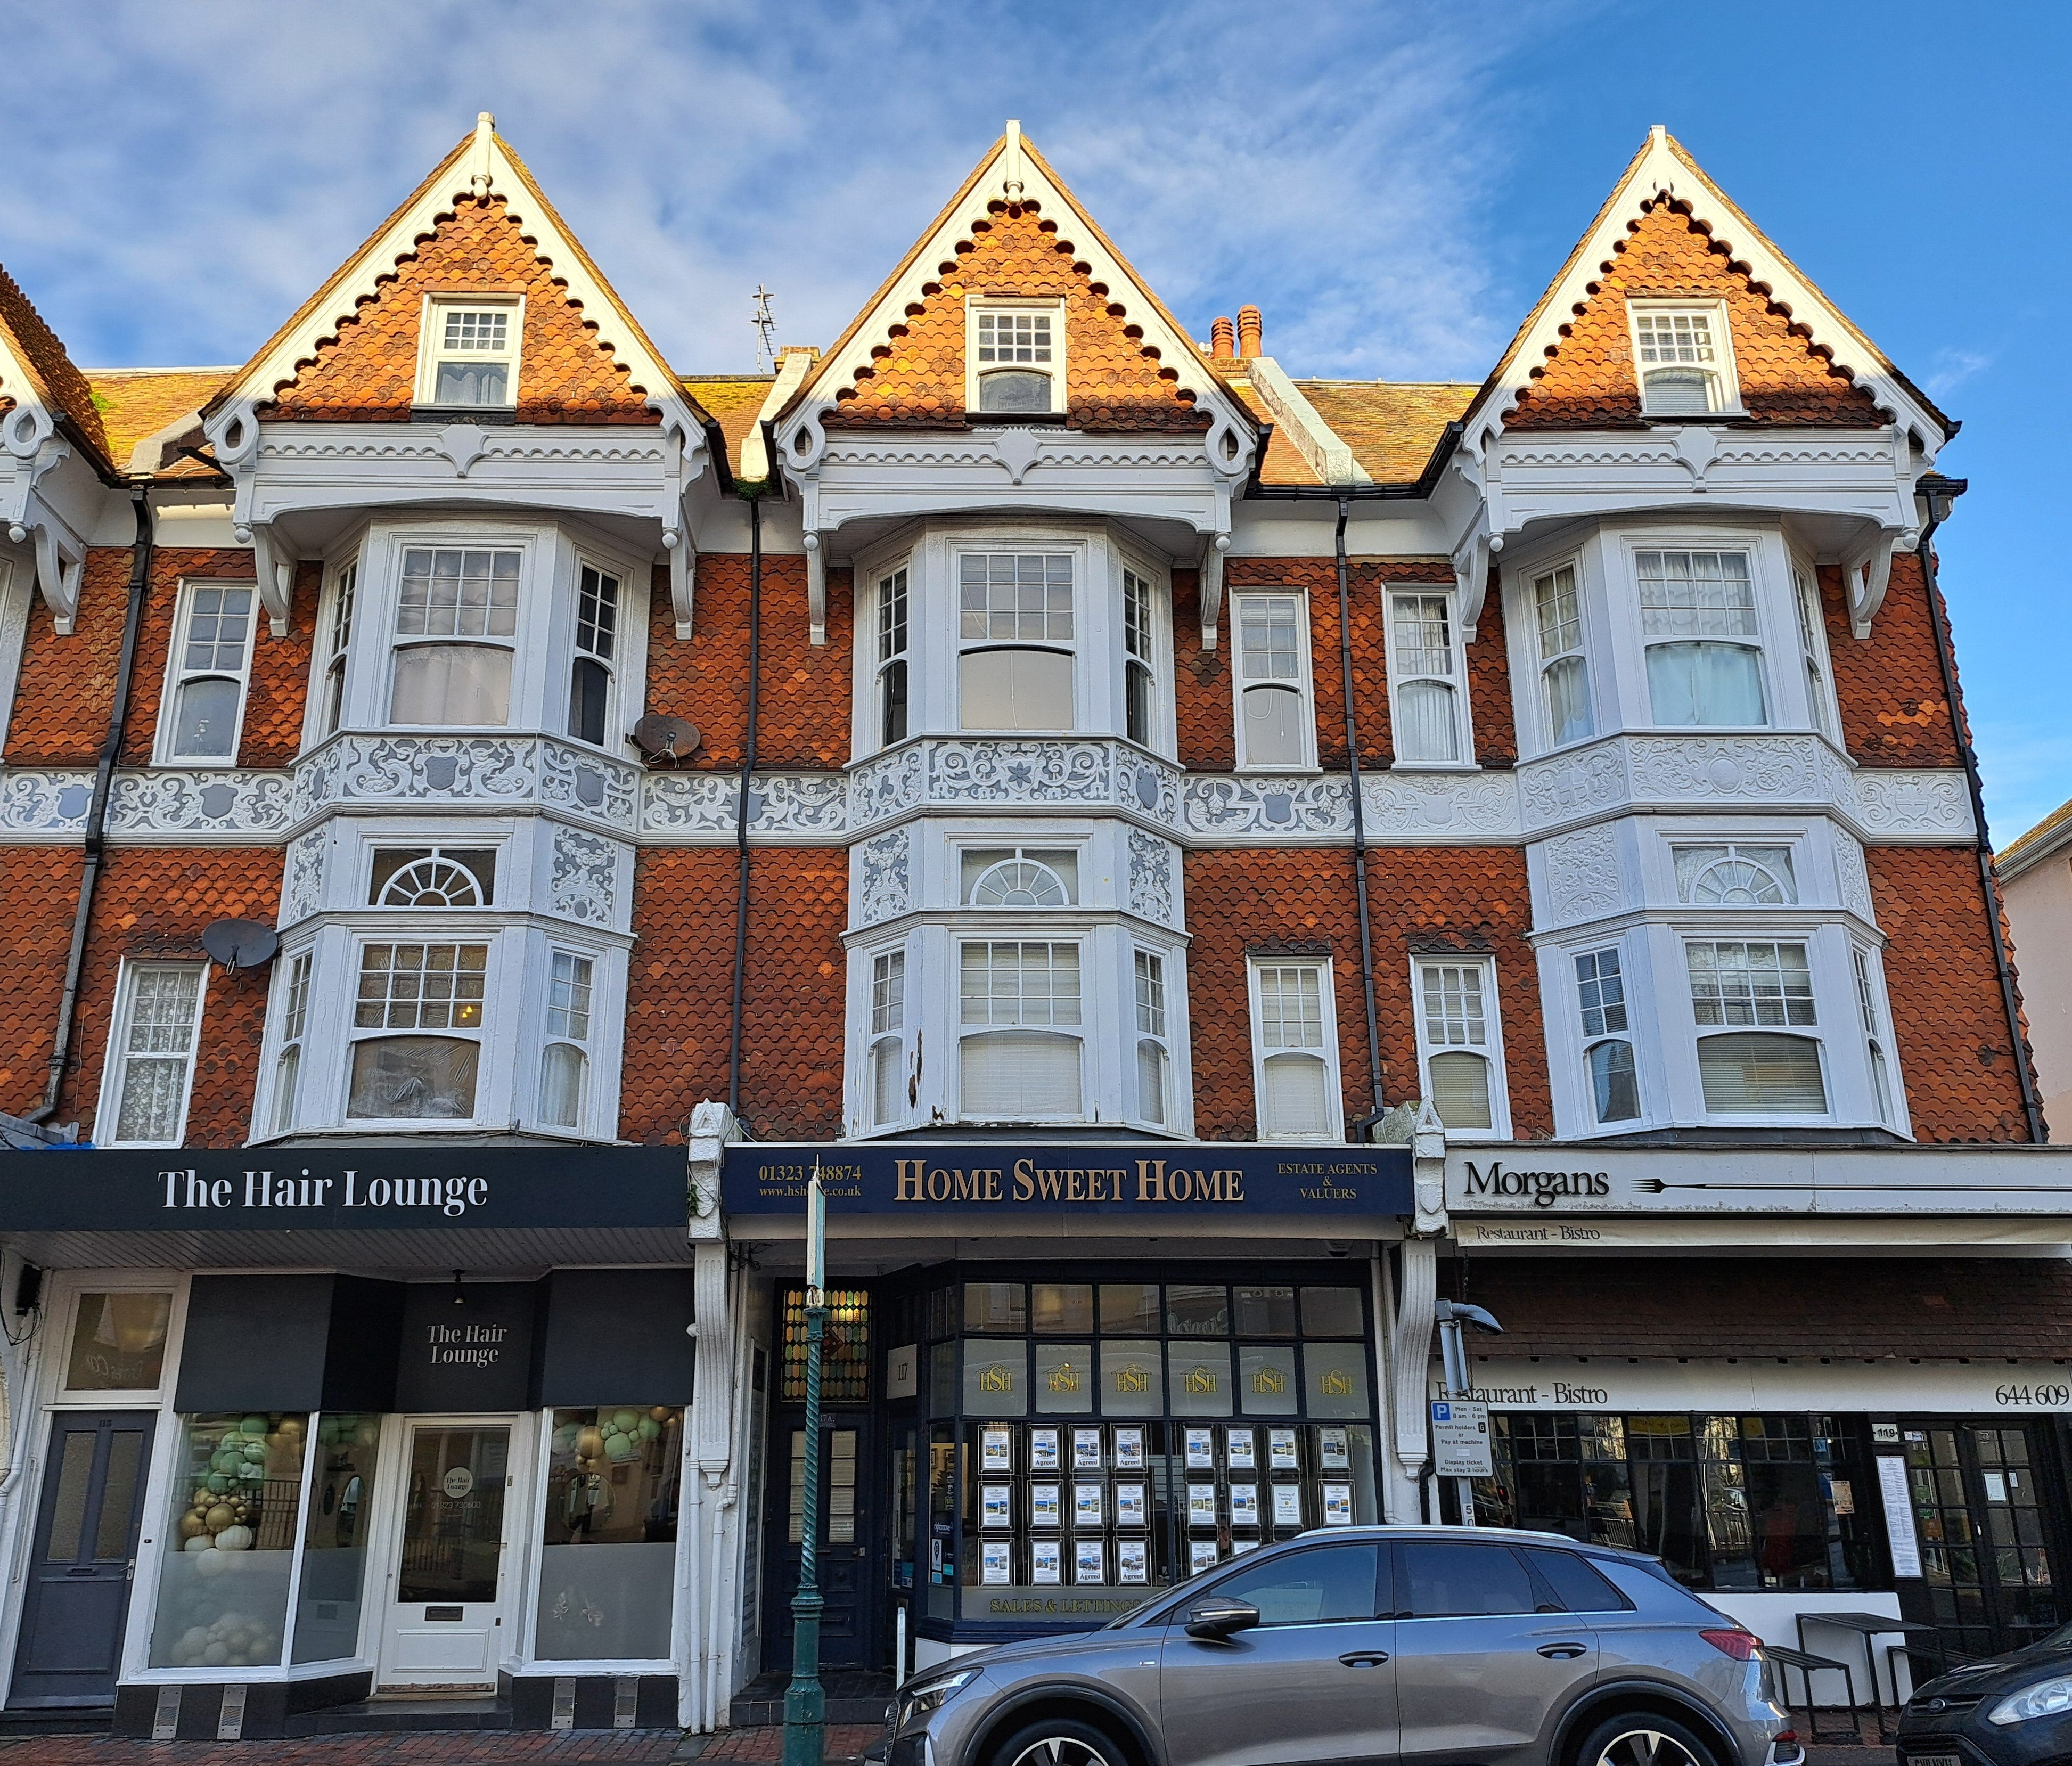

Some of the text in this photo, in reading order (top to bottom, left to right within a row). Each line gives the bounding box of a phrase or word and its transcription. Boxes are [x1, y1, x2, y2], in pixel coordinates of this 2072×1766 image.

[759, 1165, 862, 1181] 01323 748874
[1277, 1163, 1378, 1175] ESTATE AGENTS
[894, 1158, 1245, 1201] HOME SWEET HOME
[1323, 1175, 1332, 1187] &
[1464, 1162, 1610, 1207] Morgans
[158, 1168, 488, 1217] The Hair Lounge
[759, 1185, 862, 1197] www.hshe.co.uk
[1299, 1188, 1357, 1199] VALUERS
[1476, 1225, 1549, 1240] Restaurant
[1559, 1225, 1600, 1240] Bistro
[427, 1323, 507, 1343] The Hair
[430, 1346, 498, 1368] Lounge
[898, 1362, 908, 1380] 117
[980, 1366, 1012, 1392] HSH
[1048, 1366, 1079, 1392] HSH
[1116, 1367, 1148, 1392] HSH
[1184, 1368, 1217, 1393] HSH
[1252, 1368, 1285, 1393] HSH
[1321, 1370, 1352, 1394] HSH
[1436, 1381, 1538, 1404] Rtaurant
[1552, 1383, 1608, 1404] Bistro
[1995, 1385, 2069, 1405] 644 609
[1437, 1405, 1447, 1418] P
[1878, 1428, 1895, 1437] 119
[1466, 1505, 1472, 1514] 5
[990, 1599, 1042, 1613] SALES
[1044, 1599, 1057, 1613] &
